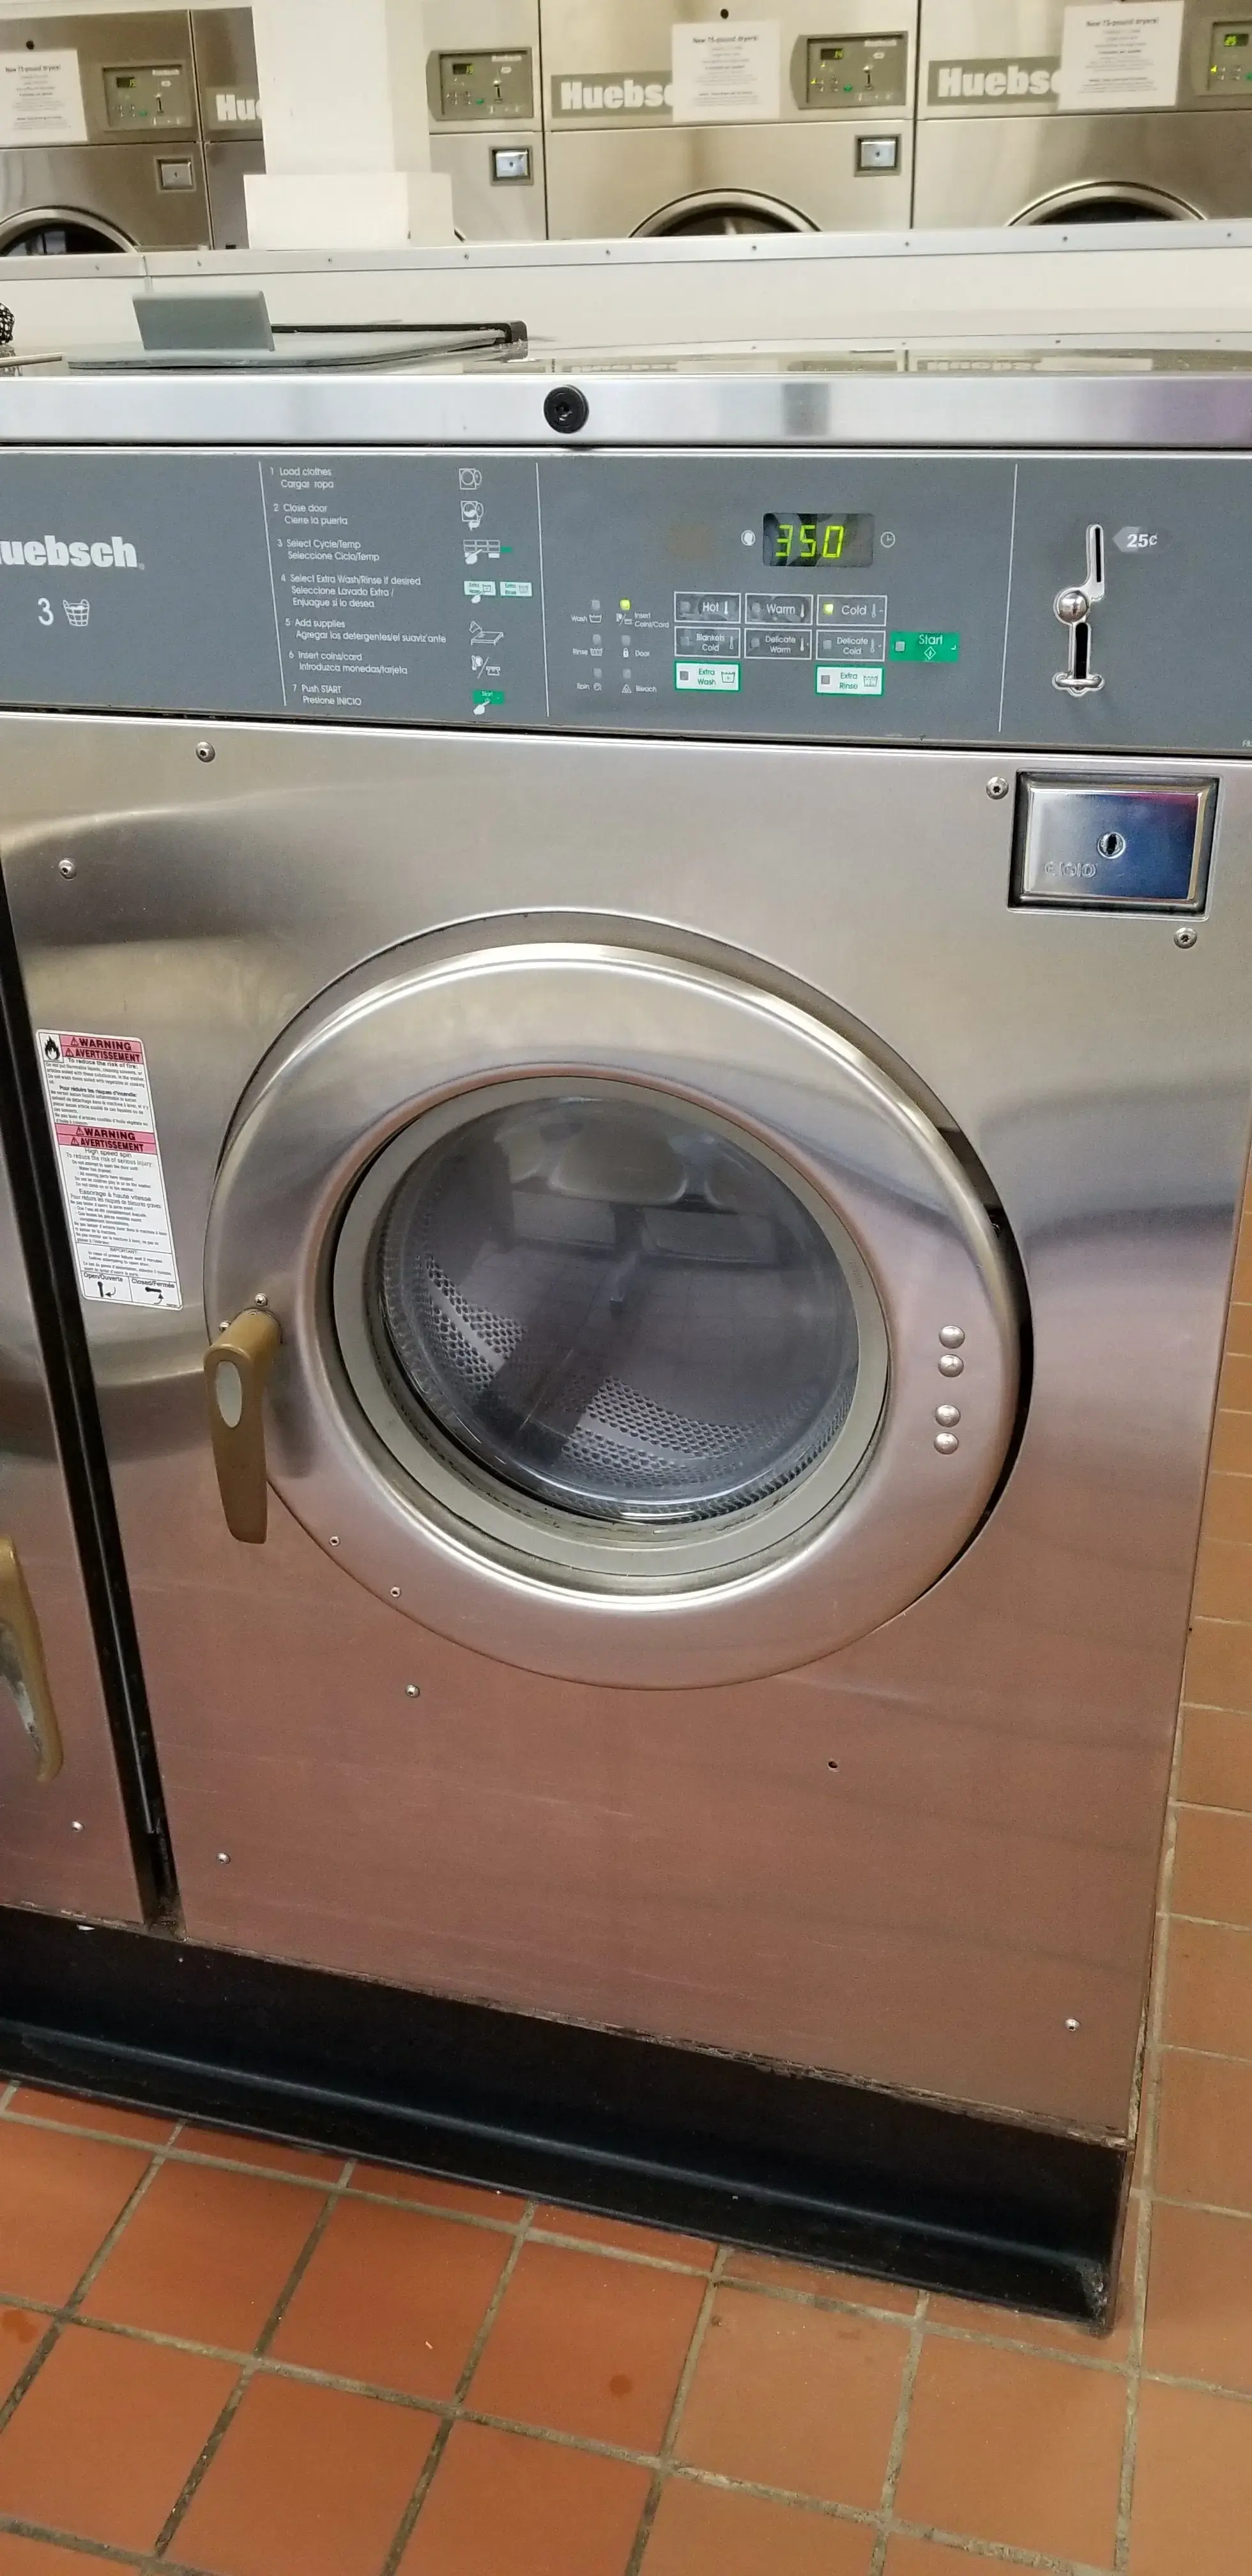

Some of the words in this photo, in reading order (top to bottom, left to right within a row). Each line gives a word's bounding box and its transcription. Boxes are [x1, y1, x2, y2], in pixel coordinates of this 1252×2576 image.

[302, 468, 332, 476] clothes
[281, 480, 310, 489] Cargar
[314, 481, 333, 490] ropa
[284, 516, 309, 524] Cierre
[311, 516, 319, 525] la
[321, 517, 347, 526] puerta
[287, 539, 311, 548] Select
[314, 540, 361, 549] Cycle/Temp
[775, 525, 844, 557] 350
[1127, 532, 1157, 548] 25¢
[288, 551, 332, 560] Seleccione
[335, 552, 379, 562] Ciclo/Temp
[290, 574, 314, 583] Select
[317, 575, 335, 583] Extra
[337, 576, 382, 584] Wash/Rinse
[391, 576, 421, 585] desired
[292, 586, 335, 595] Seleccione
[338, 587, 368, 595] Lavado
[293, 597, 330, 608] Enjuague
[340, 599, 347, 607] lo
[349, 599, 374, 608] desea
[703, 602, 719, 612] Hot
[37, 597, 54, 626] 3
[767, 604, 795, 614] Warm
[841, 605, 867, 615] Cold
[295, 618, 312, 627] Add
[313, 619, 345, 629] supplies
[296, 631, 328, 640] Agregar
[696, 634, 725, 642] Blankets
[919, 634, 943, 645] Start
[321, 652, 362, 661] coins/card
[299, 663, 340, 671] Introduzca
[302, 684, 319, 693] Push
[321, 685, 342, 693] START
[303, 696, 334, 705] Presione
[79, 1038, 132, 1050] WARNING
[74, 1048, 141, 1062] AVERTISSEMENT
[83, 1128, 135, 1140] WARNING
[80, 1138, 144, 1152] AVERTISSEMENT
